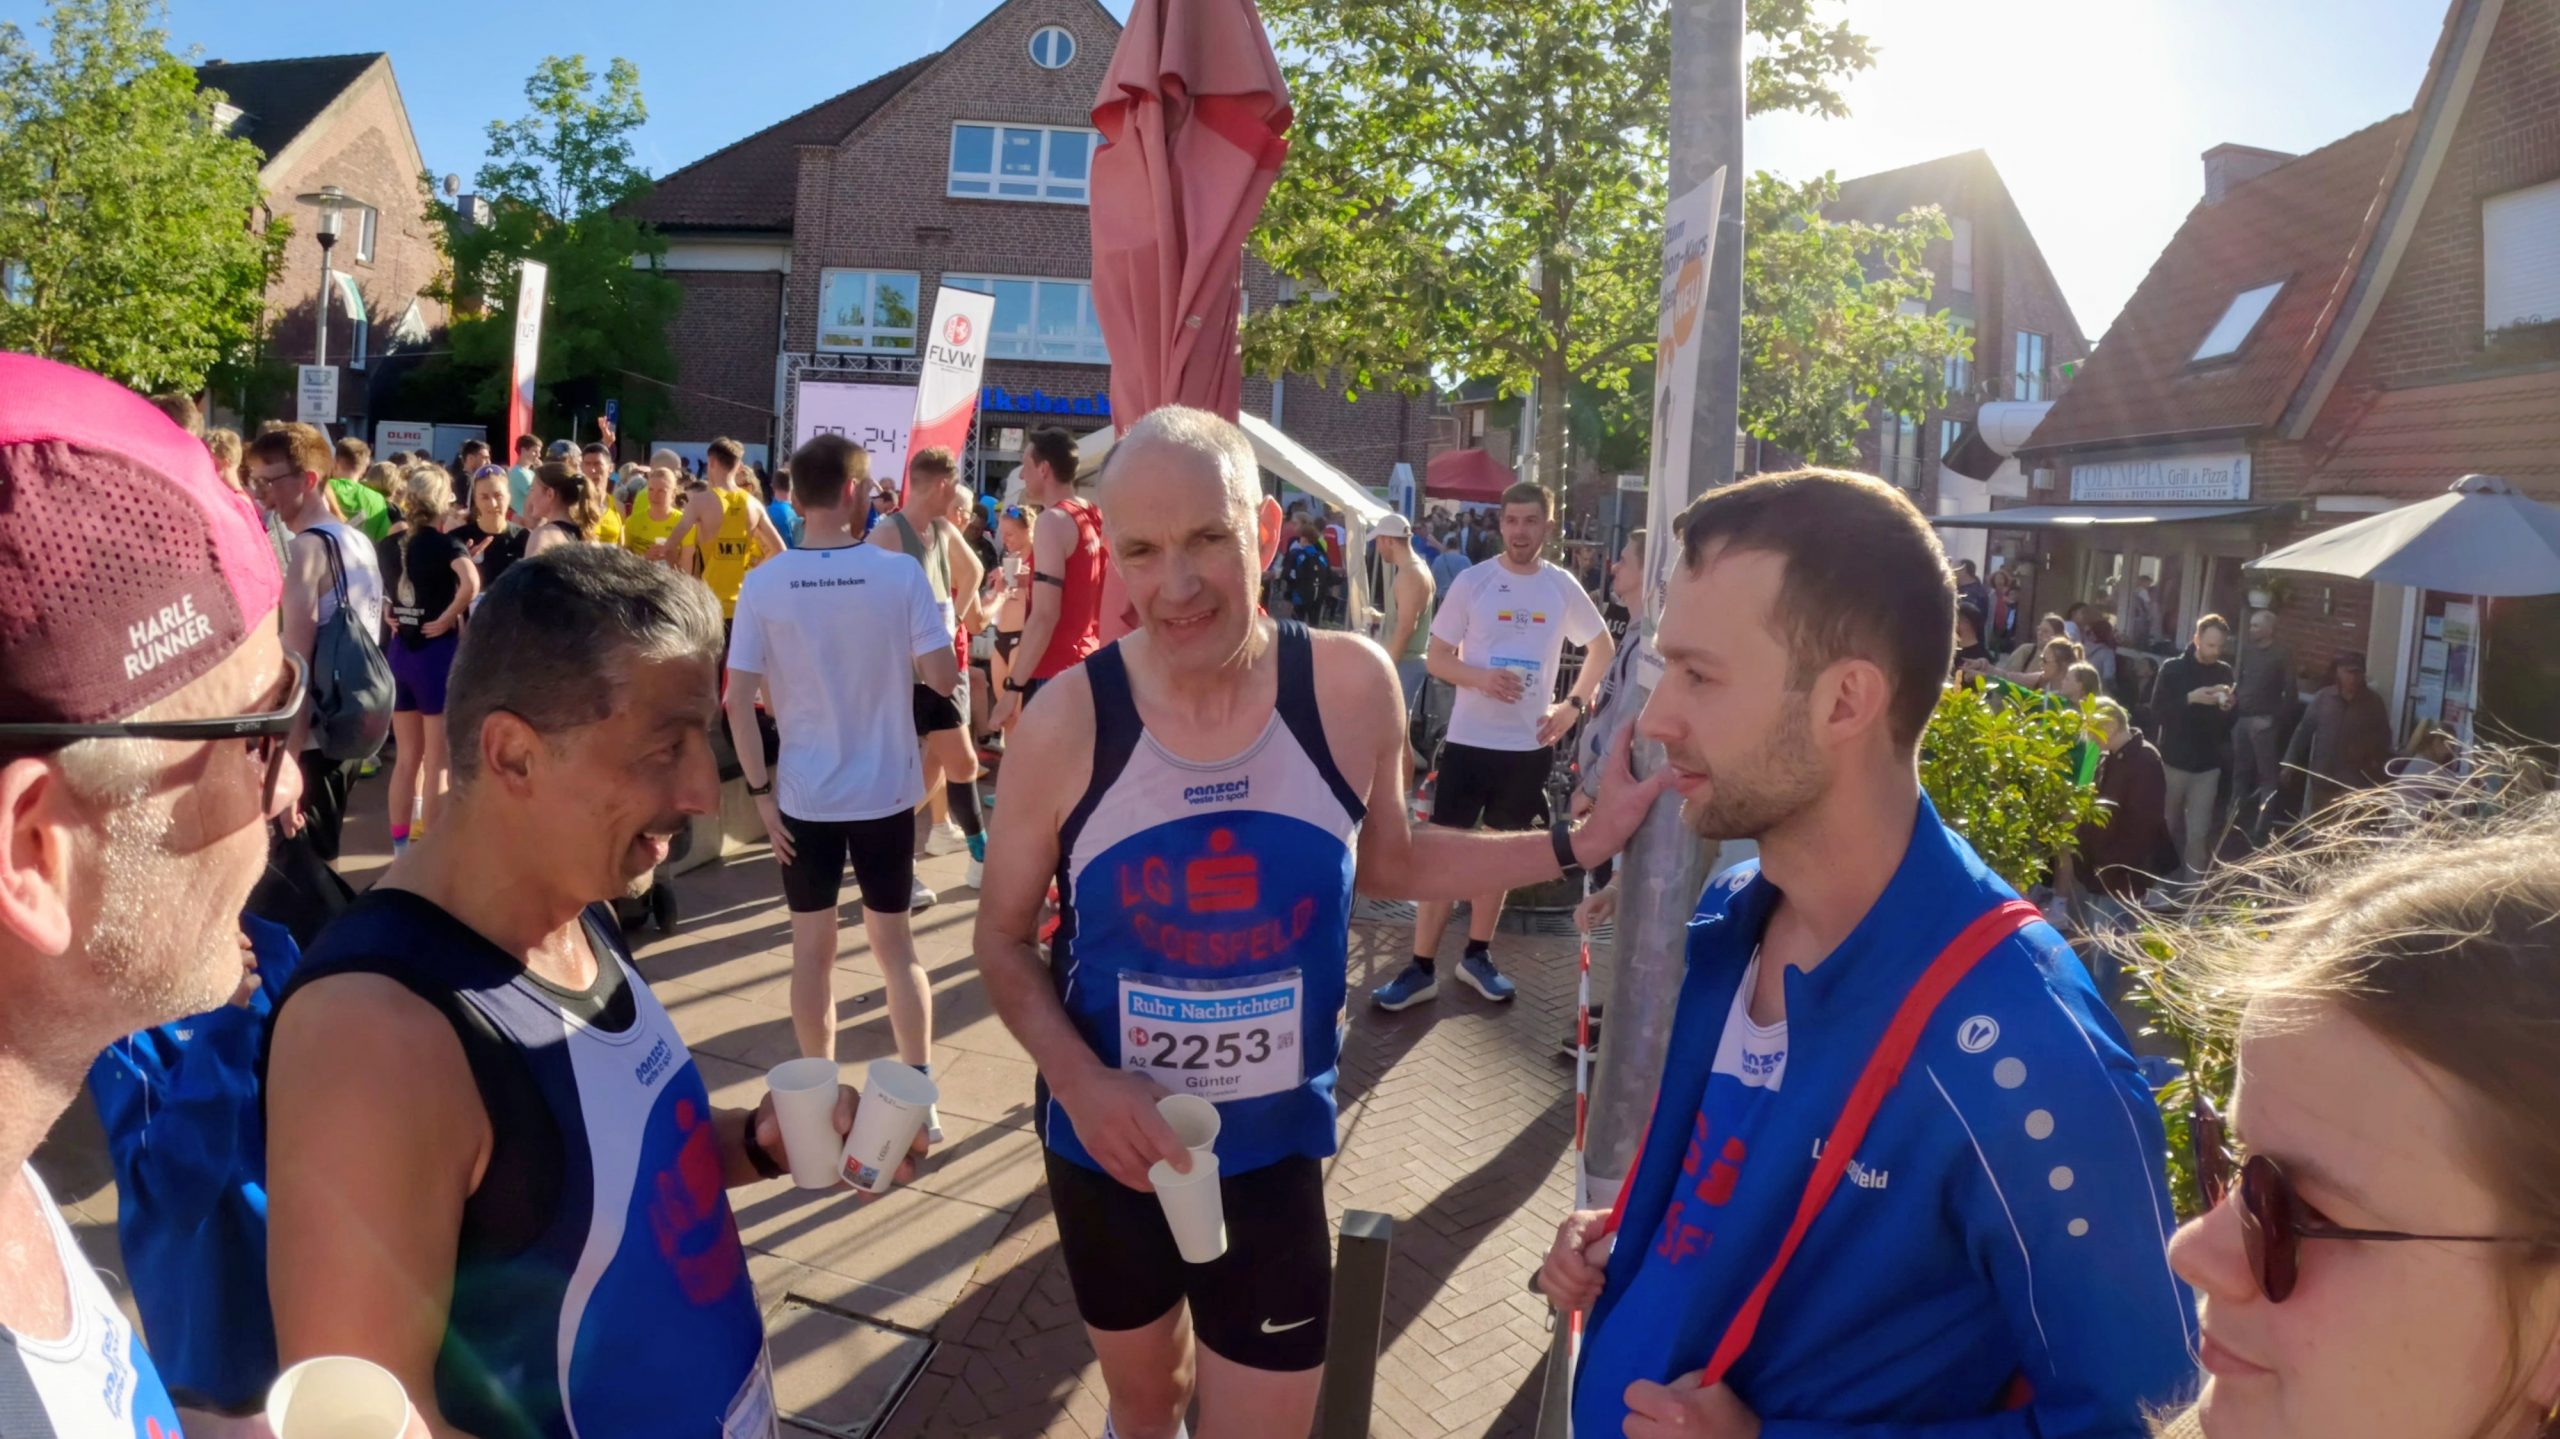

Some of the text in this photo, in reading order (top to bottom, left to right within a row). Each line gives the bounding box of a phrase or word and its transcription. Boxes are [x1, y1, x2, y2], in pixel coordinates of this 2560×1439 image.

[1676, 275, 1700, 322] NEU
[929, 345, 976, 368] FLVW
[609, 403, 616, 414] P
[387, 432, 422, 440] DLRG
[2084, 463, 2165, 487] OLYMPIA
[2168, 468, 2189, 485] Grill
[2202, 467, 2228, 484] Pizza
[790, 581, 799, 589] SG
[801, 580, 817, 588] Rote
[819, 578, 835, 587] Erde
[128, 593, 197, 650] HARLE
[123, 613, 215, 681] RUNNER
[1183, 775, 1249, 800] panzeri
[1189, 796, 1214, 805] veste
[1225, 791, 1249, 803] sport
[1120, 855, 1172, 908] LG
[1132, 995, 1290, 1020] Ruhr Nachrichten
[1151, 1028, 1271, 1070] 2253
[1129, 1055, 1147, 1068] A2
[1185, 1074, 1242, 1088] Günter
